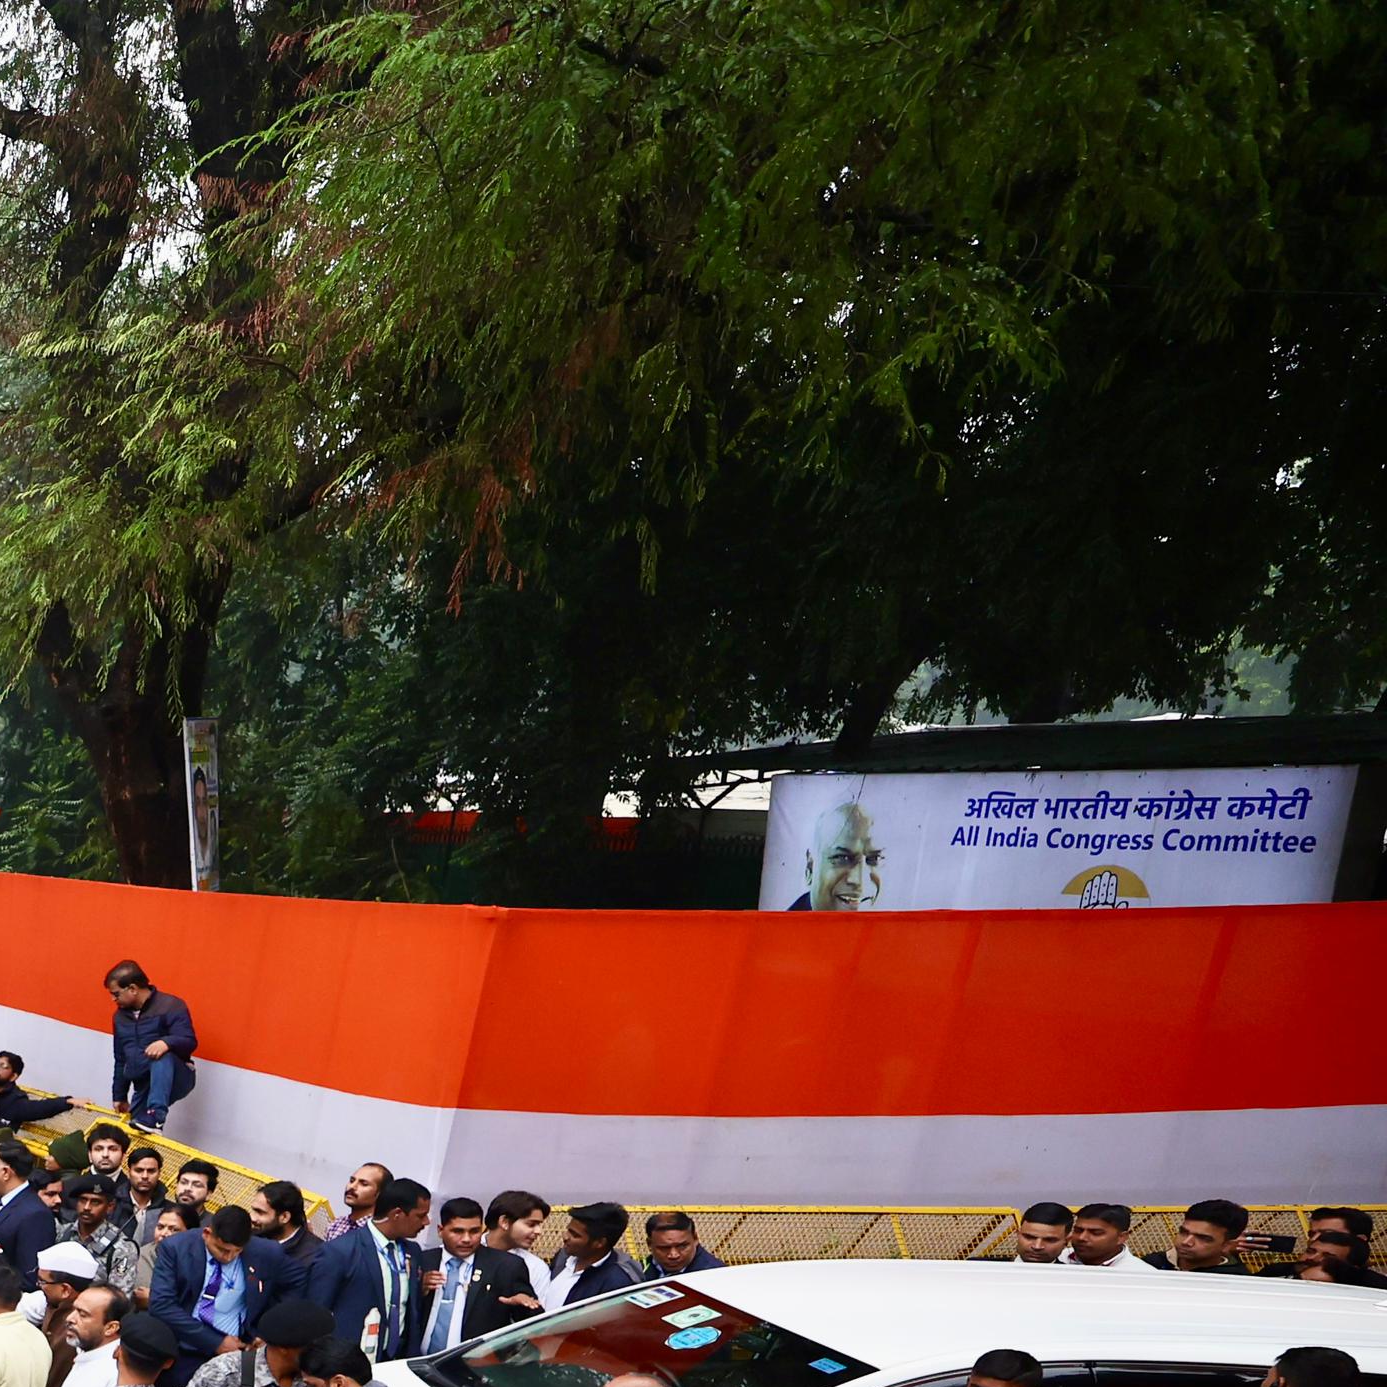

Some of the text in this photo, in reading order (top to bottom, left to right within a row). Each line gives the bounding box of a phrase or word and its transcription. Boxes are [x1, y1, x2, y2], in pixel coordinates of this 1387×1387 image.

[964, 788, 1313, 821] अखिल भारतीय कांग्रेस कमेटी
[951, 826, 1317, 855] All India Congress Committee
